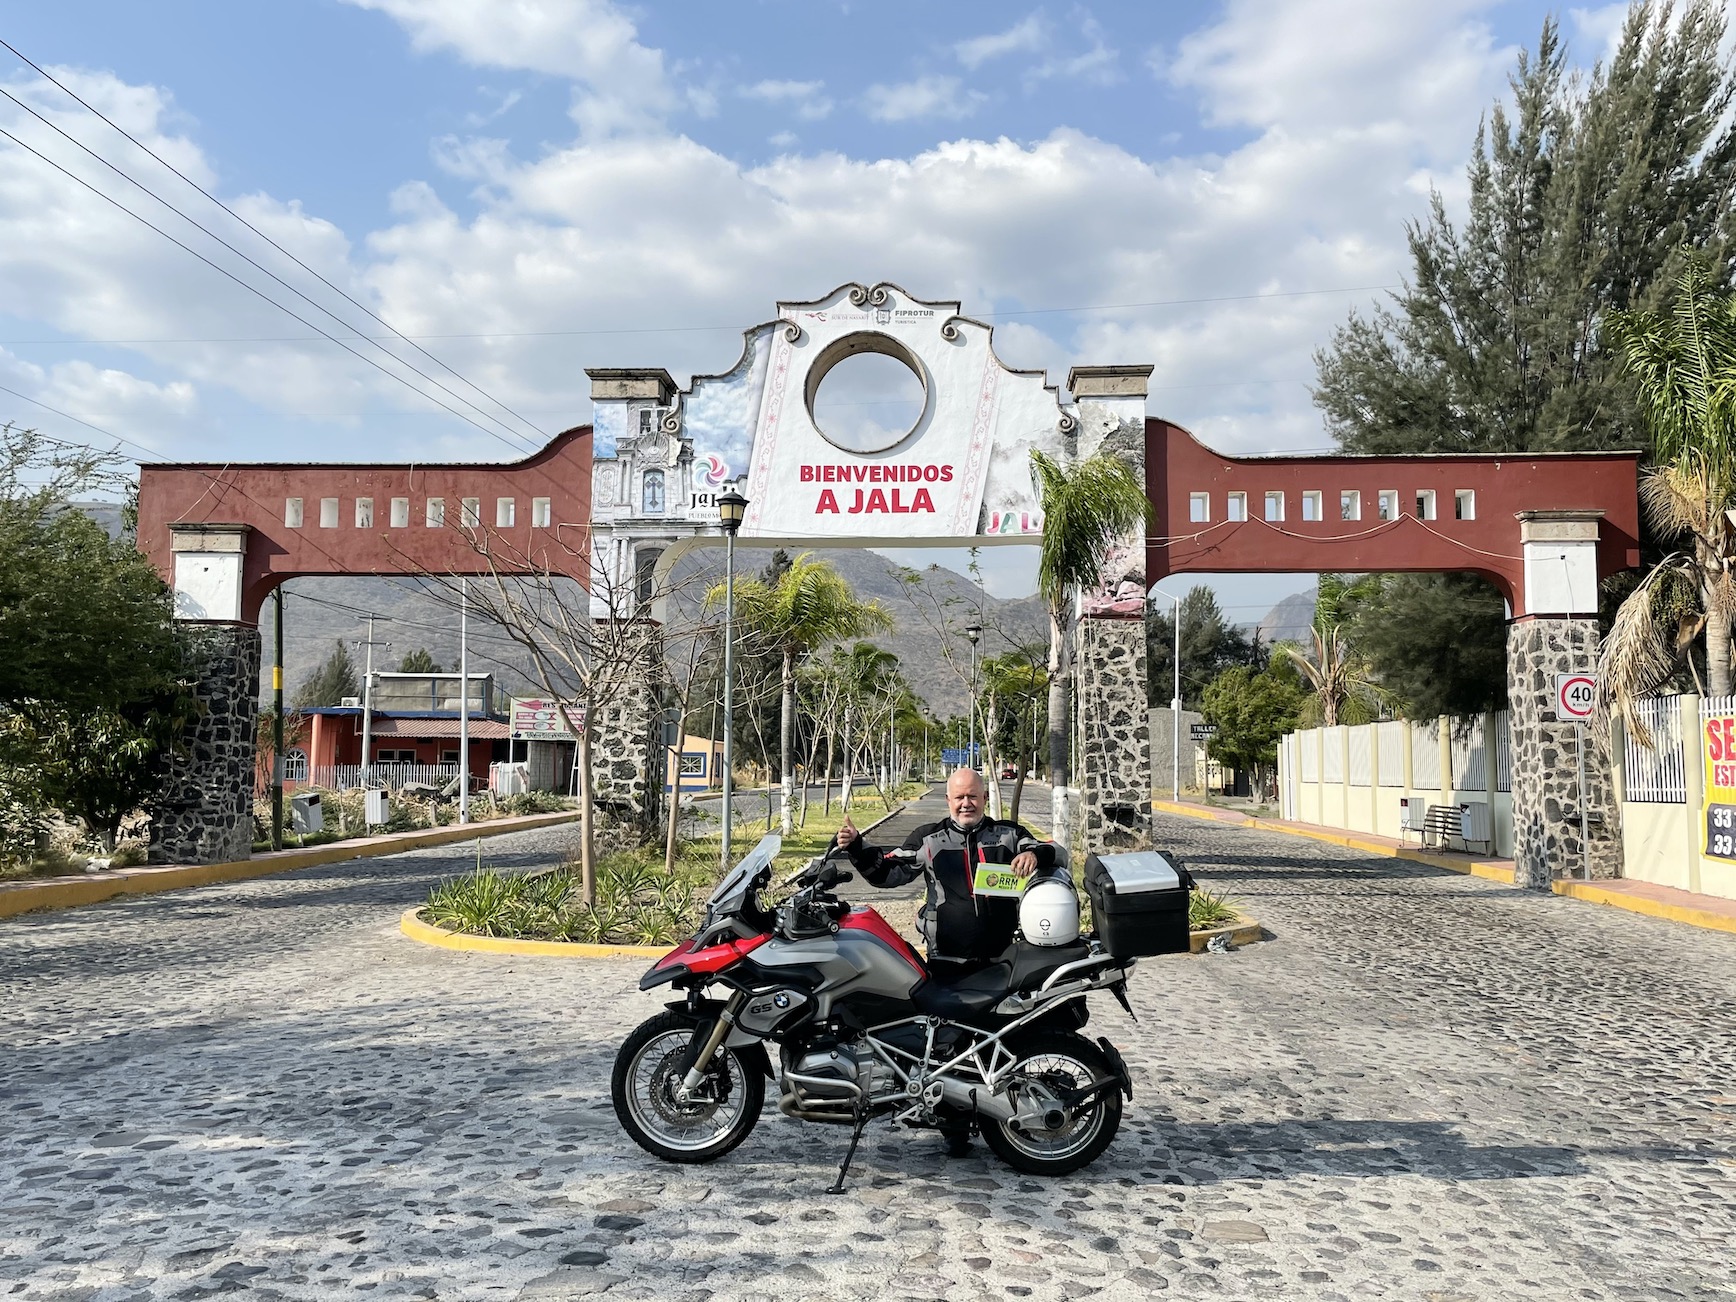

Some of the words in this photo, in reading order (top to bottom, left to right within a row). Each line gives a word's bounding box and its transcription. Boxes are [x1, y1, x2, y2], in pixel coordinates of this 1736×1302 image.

[800, 465, 954, 482] BIENVENIDOS
[815, 489, 840, 514] A
[847, 488, 936, 514] JALA
[987, 512, 1043, 534] JAL
[1571, 687, 1591, 701] 40
[1713, 808, 1732, 828] 33
[1713, 834, 1732, 855] 33
[999, 877, 1018, 886] RRM
[751, 1003, 772, 1013] GS
